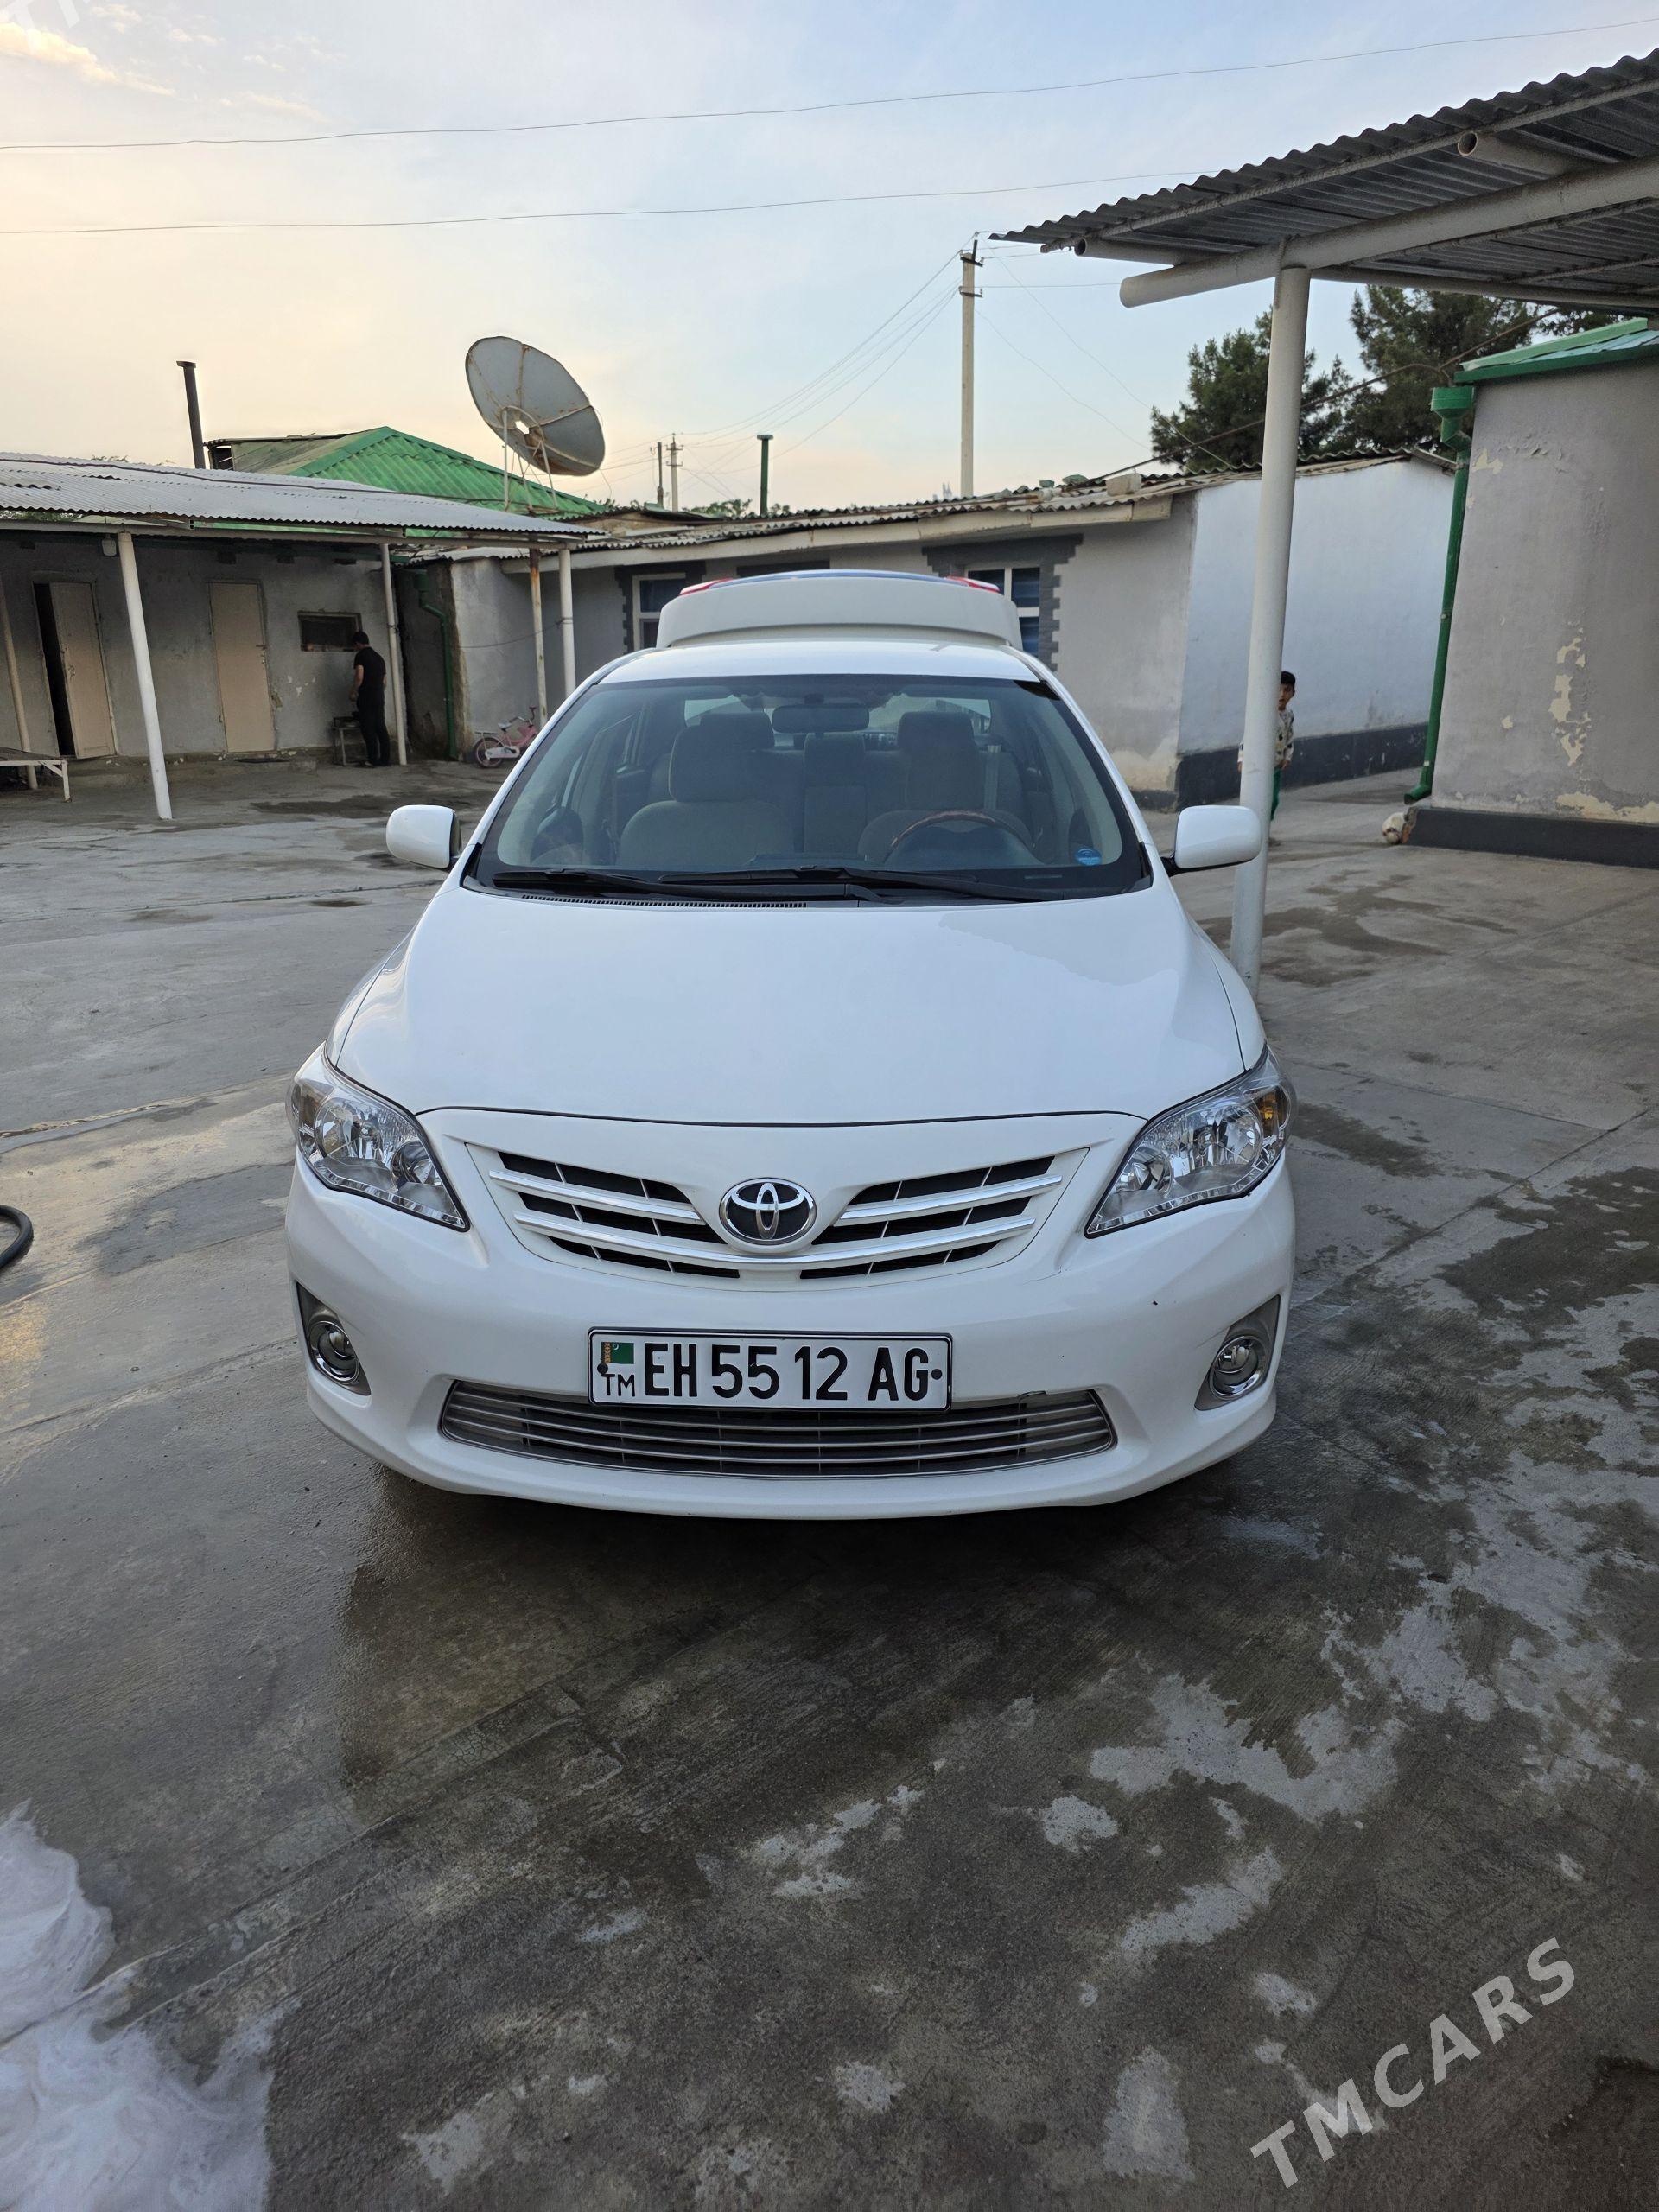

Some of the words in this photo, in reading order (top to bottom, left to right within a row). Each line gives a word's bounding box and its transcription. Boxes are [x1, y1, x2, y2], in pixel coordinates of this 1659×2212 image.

[601, 1374, 636, 1397] TM
[645, 1343, 698, 1397] EH
[711, 1345, 780, 1400] 55
[794, 1346, 849, 1401] 12
[867, 1347, 929, 1402] AG
